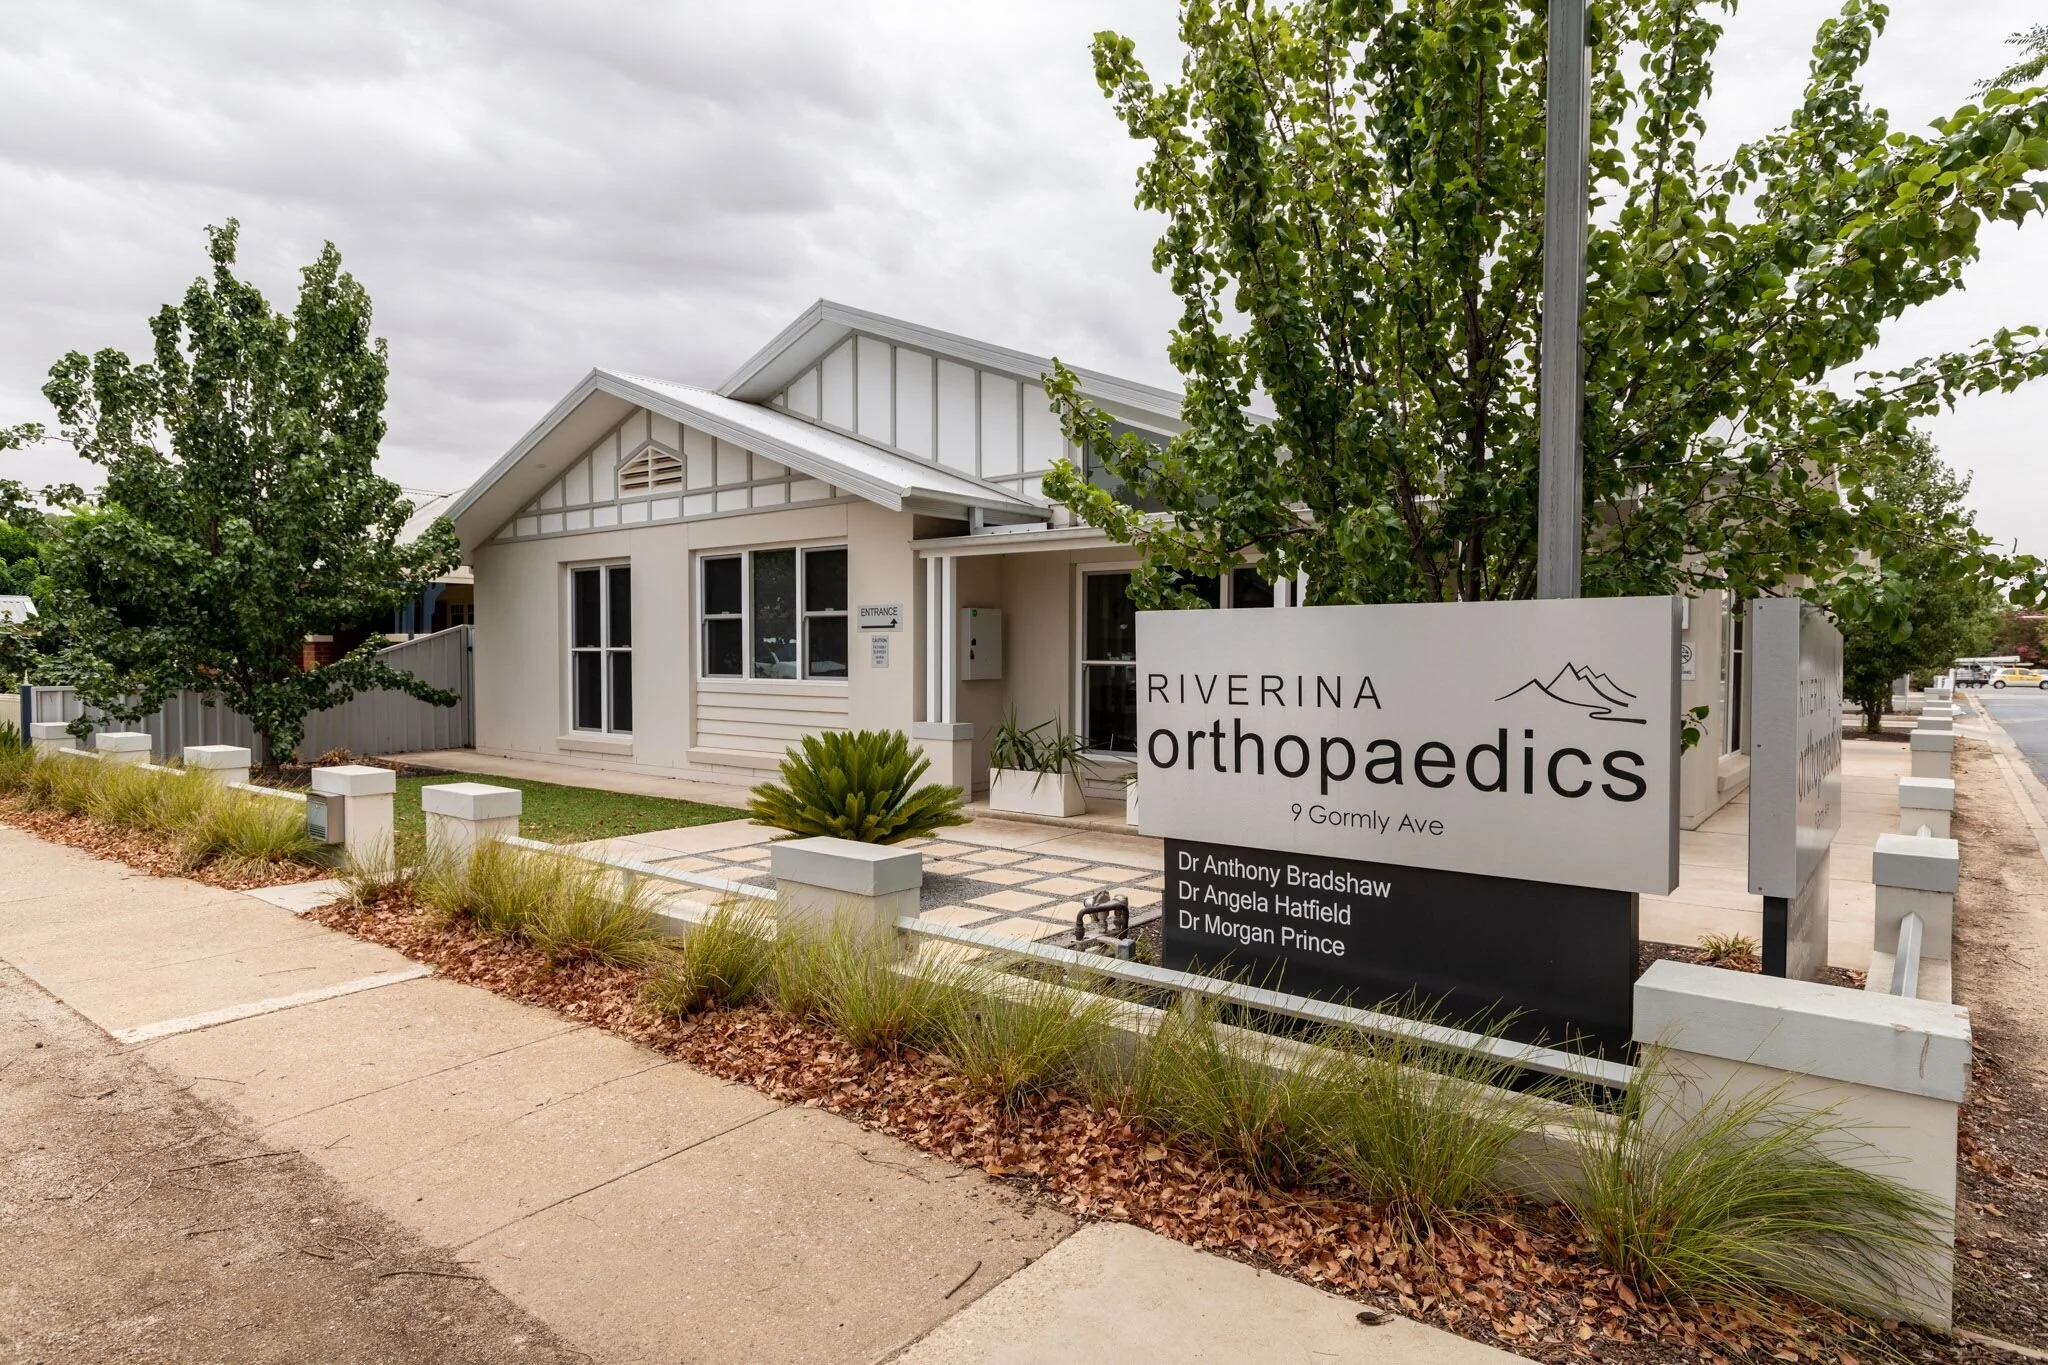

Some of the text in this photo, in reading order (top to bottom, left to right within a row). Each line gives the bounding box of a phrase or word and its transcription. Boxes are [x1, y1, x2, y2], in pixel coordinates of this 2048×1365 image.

[860, 607, 898, 617] ENTRANCE
[1148, 673, 1382, 710] RIVERINA
[1148, 717, 1648, 803] orthopaedics
[1291, 802, 1444, 836] 9 Gormly Ave
[1178, 850, 1392, 898] Dr Anthony Bradshaw
[1178, 880, 1351, 926] Dr Angela Hatfield
[1179, 909, 1345, 957] Dr Morgan Prince
